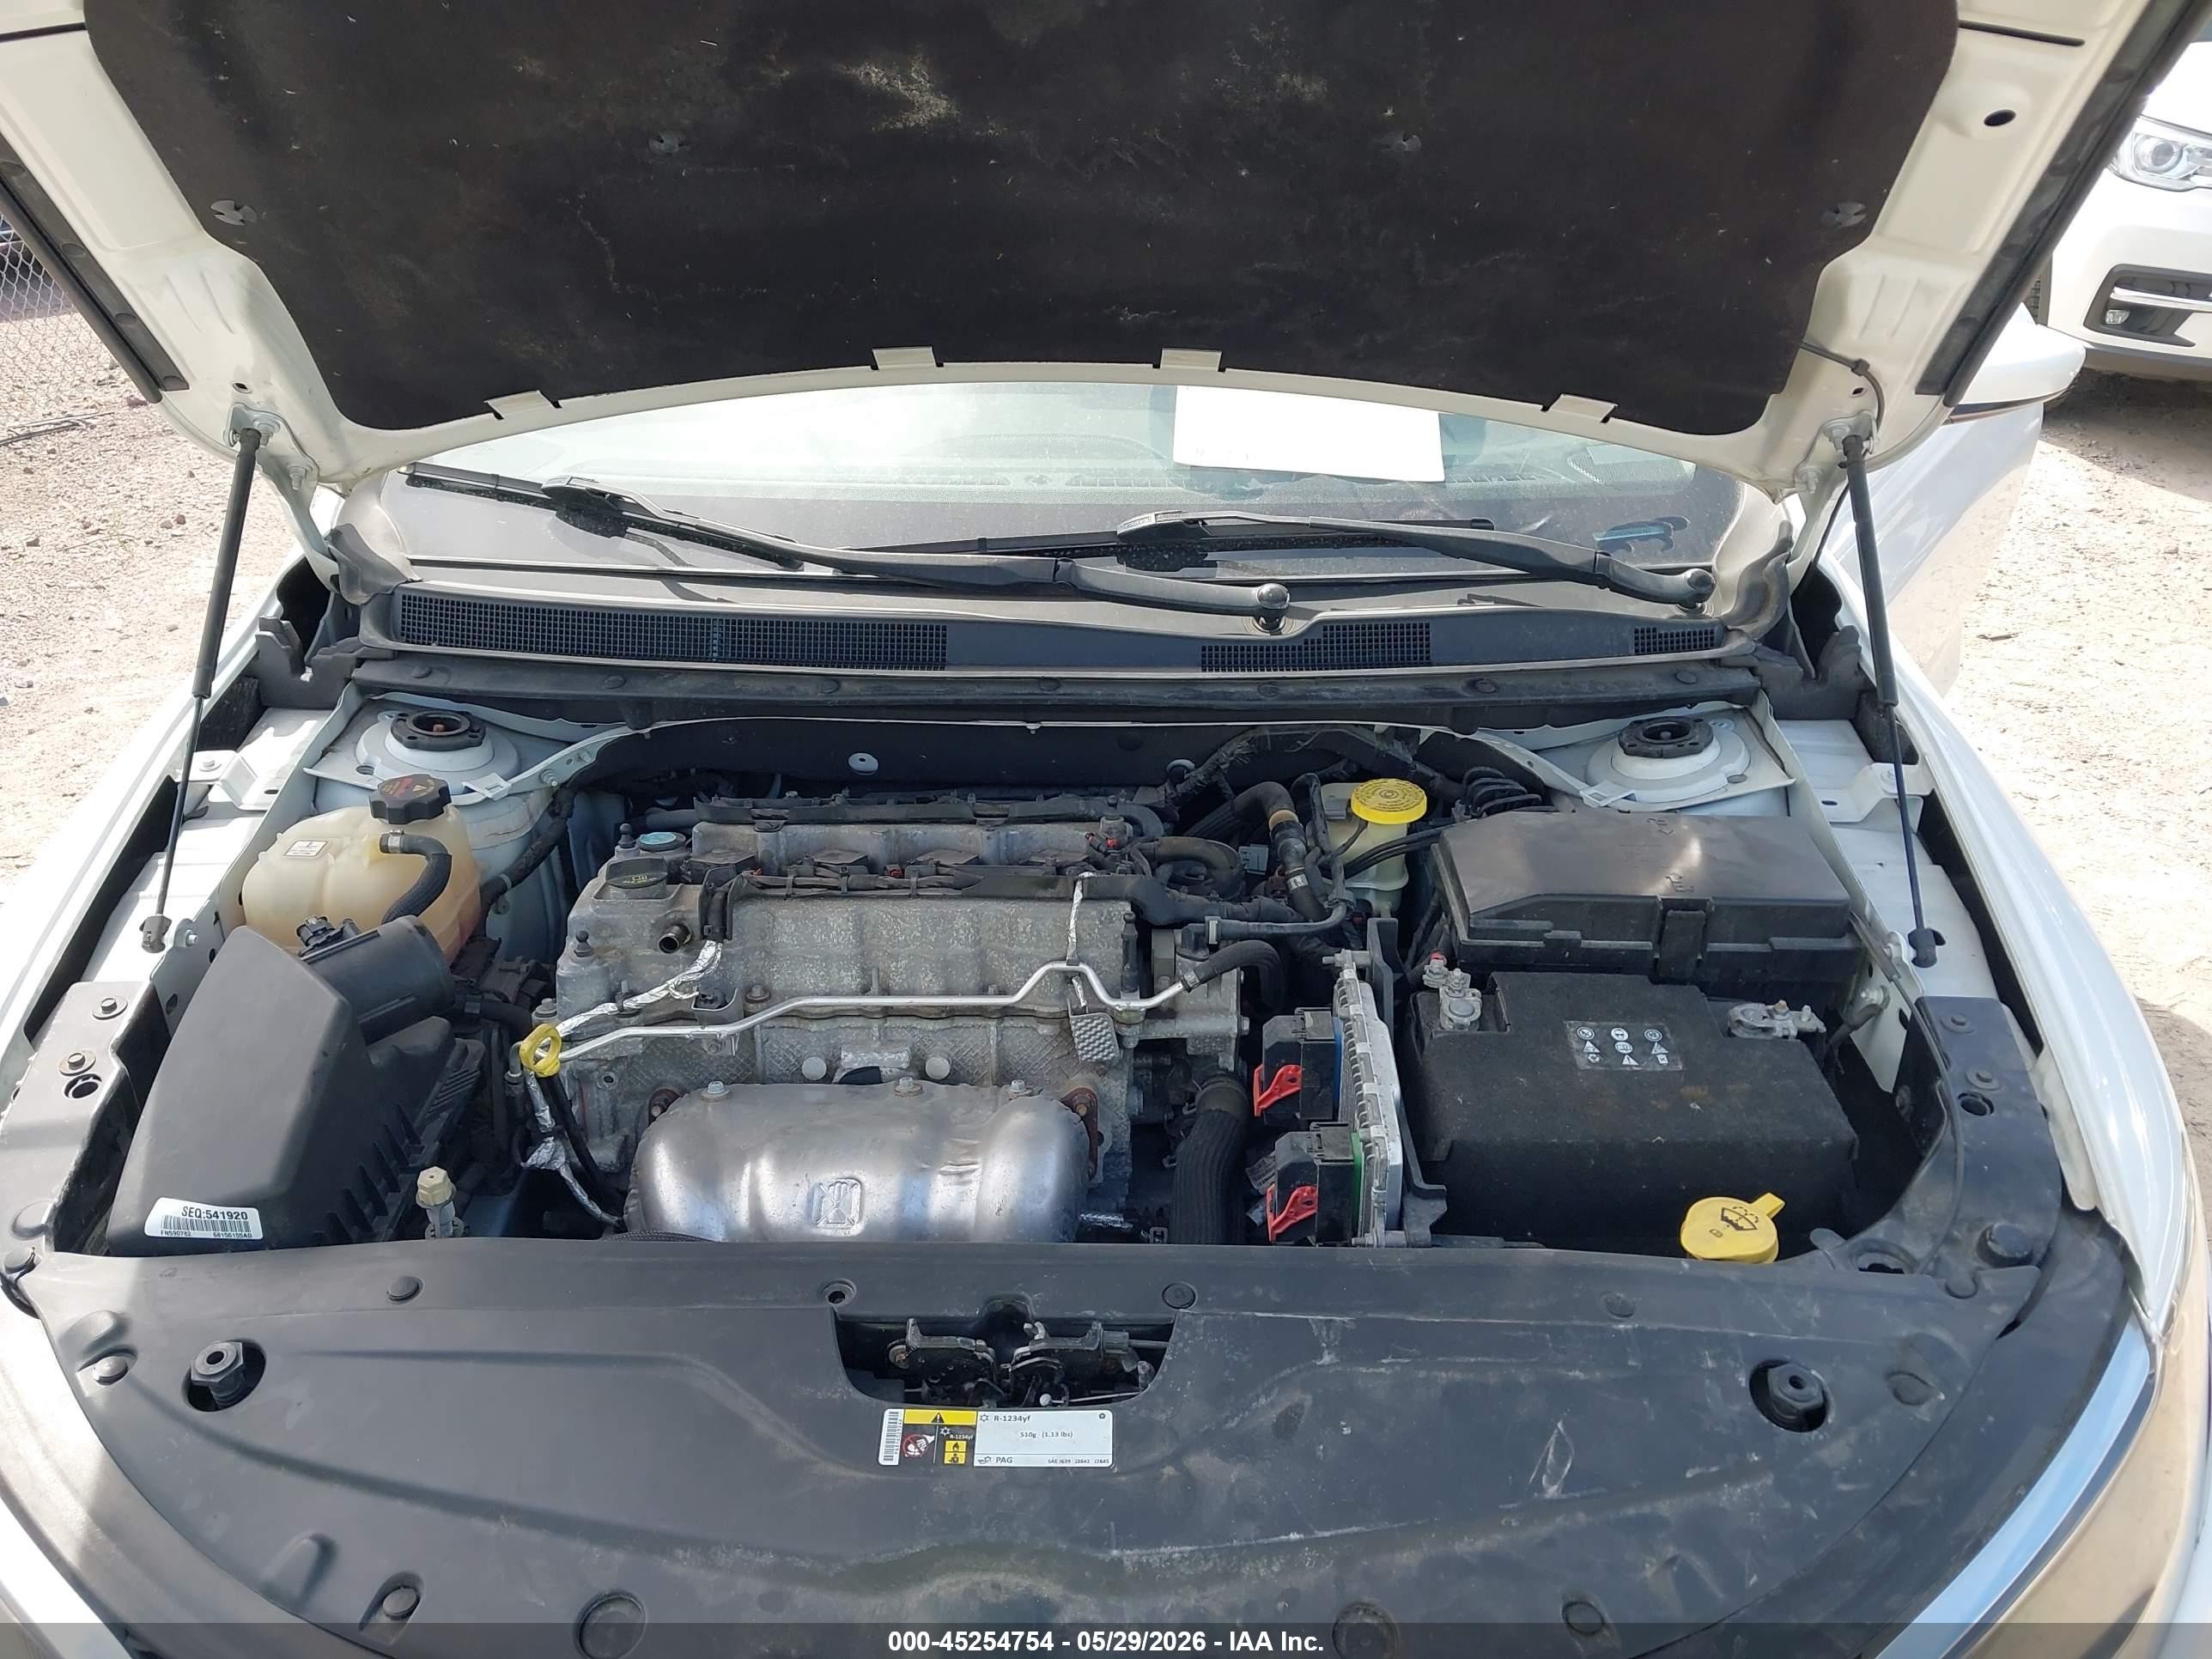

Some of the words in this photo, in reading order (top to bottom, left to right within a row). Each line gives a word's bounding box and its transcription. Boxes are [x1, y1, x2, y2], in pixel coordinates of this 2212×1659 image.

[181, 1206, 247, 1220] SEQ:541920
[994, 1415, 1030, 1424] R-1234yf
[1042, 1431, 1059, 1439] (1.13
[1060, 1431, 1073, 1439] lbs)
